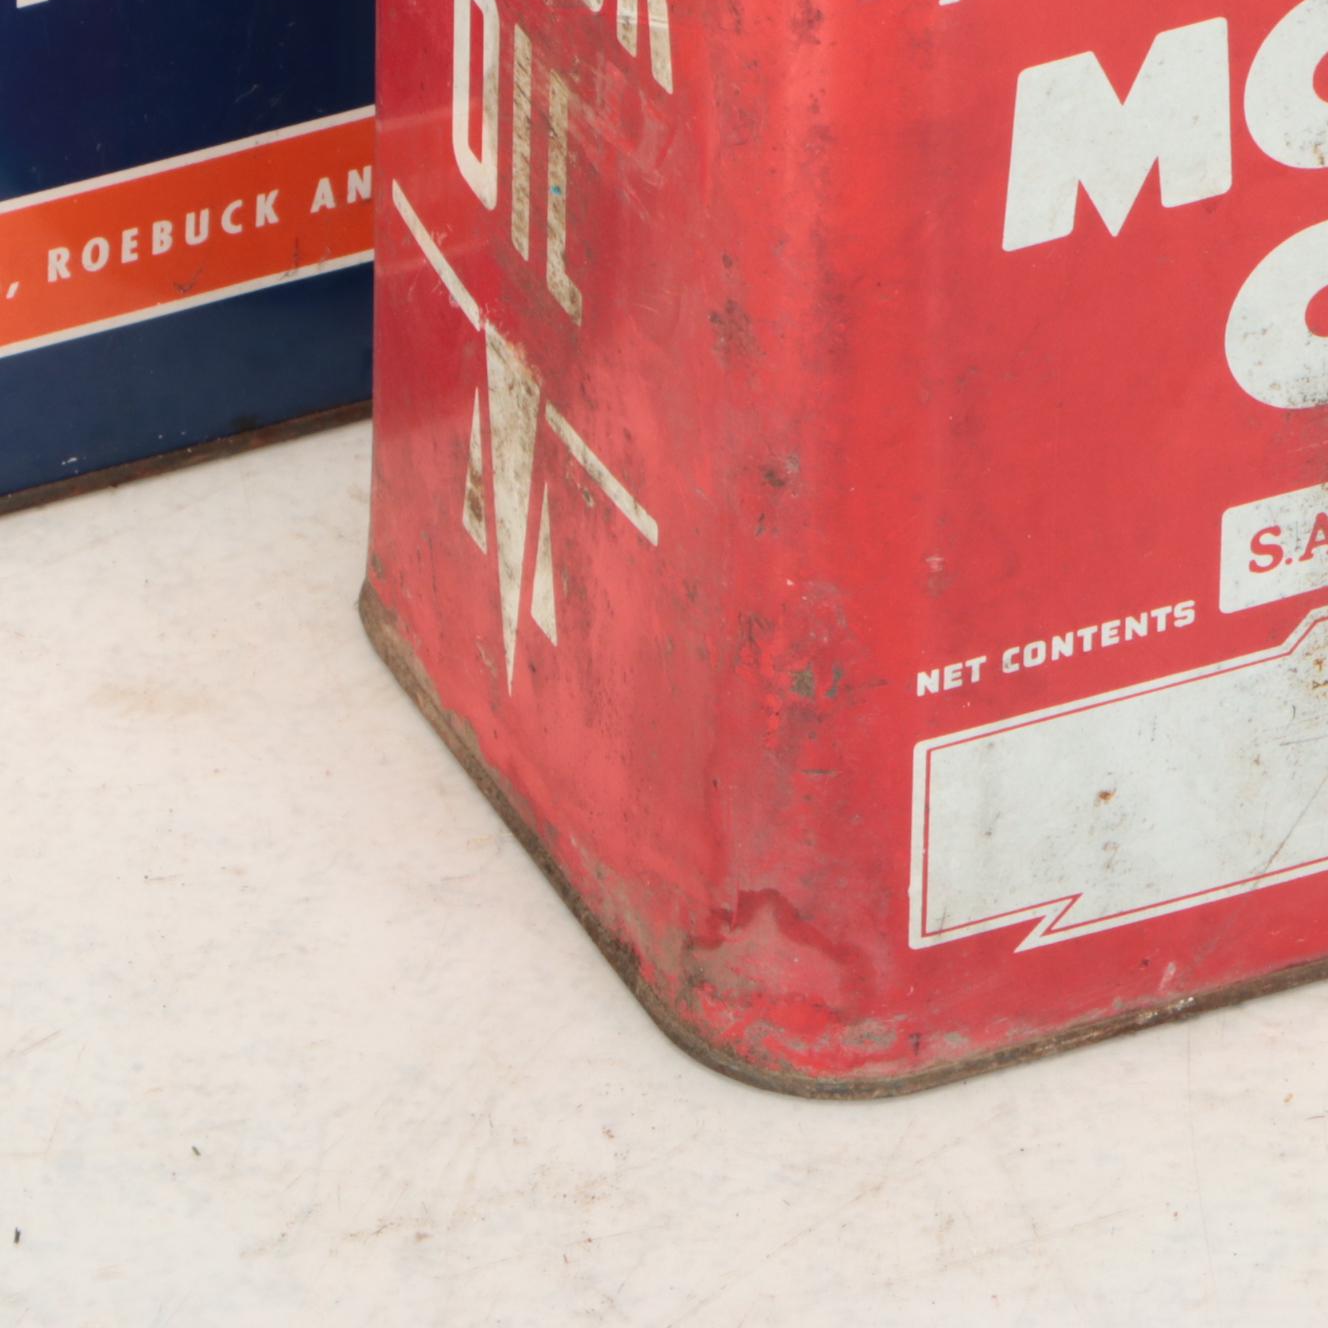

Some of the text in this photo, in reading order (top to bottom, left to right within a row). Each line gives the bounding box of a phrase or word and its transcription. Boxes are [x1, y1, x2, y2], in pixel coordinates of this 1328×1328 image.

[46, 187, 281, 284] ROEBUCK
[915, 599, 1197, 698] NET CONTENTS
